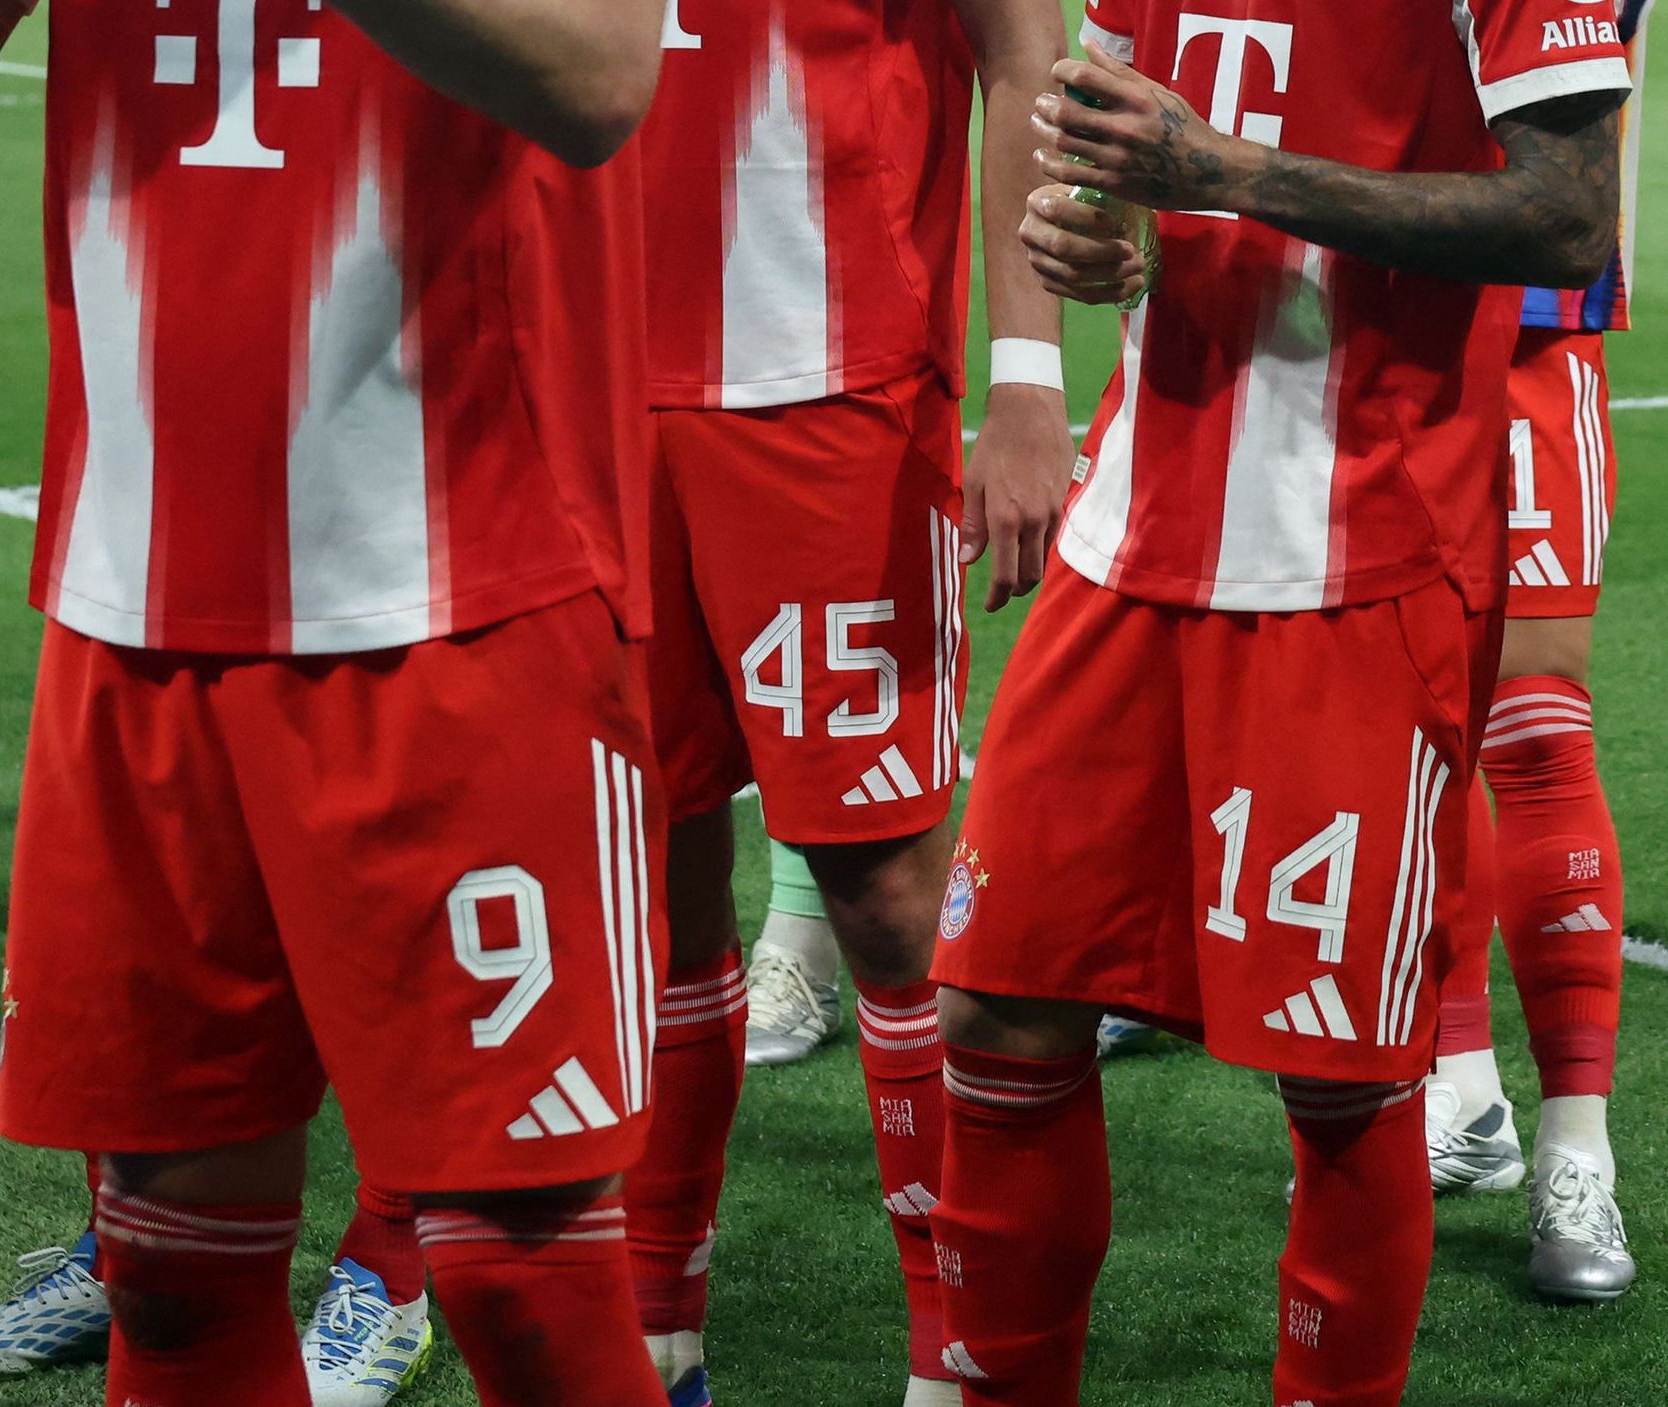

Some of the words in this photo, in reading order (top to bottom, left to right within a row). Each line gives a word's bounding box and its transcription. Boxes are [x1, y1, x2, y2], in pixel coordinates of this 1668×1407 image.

[1171, 12, 1294, 220] T
[740, 599, 900, 737] 45
[1568, 848, 1599, 861] MIA
[1569, 859, 1600, 871] SAN
[1205, 786, 1360, 964] 14
[1567, 868, 1600, 880] MIA
[448, 864, 554, 1049] 9
[880, 1096, 912, 1112] MIA
[881, 1109, 913, 1124] SAN
[883, 1122, 915, 1137] MIA
